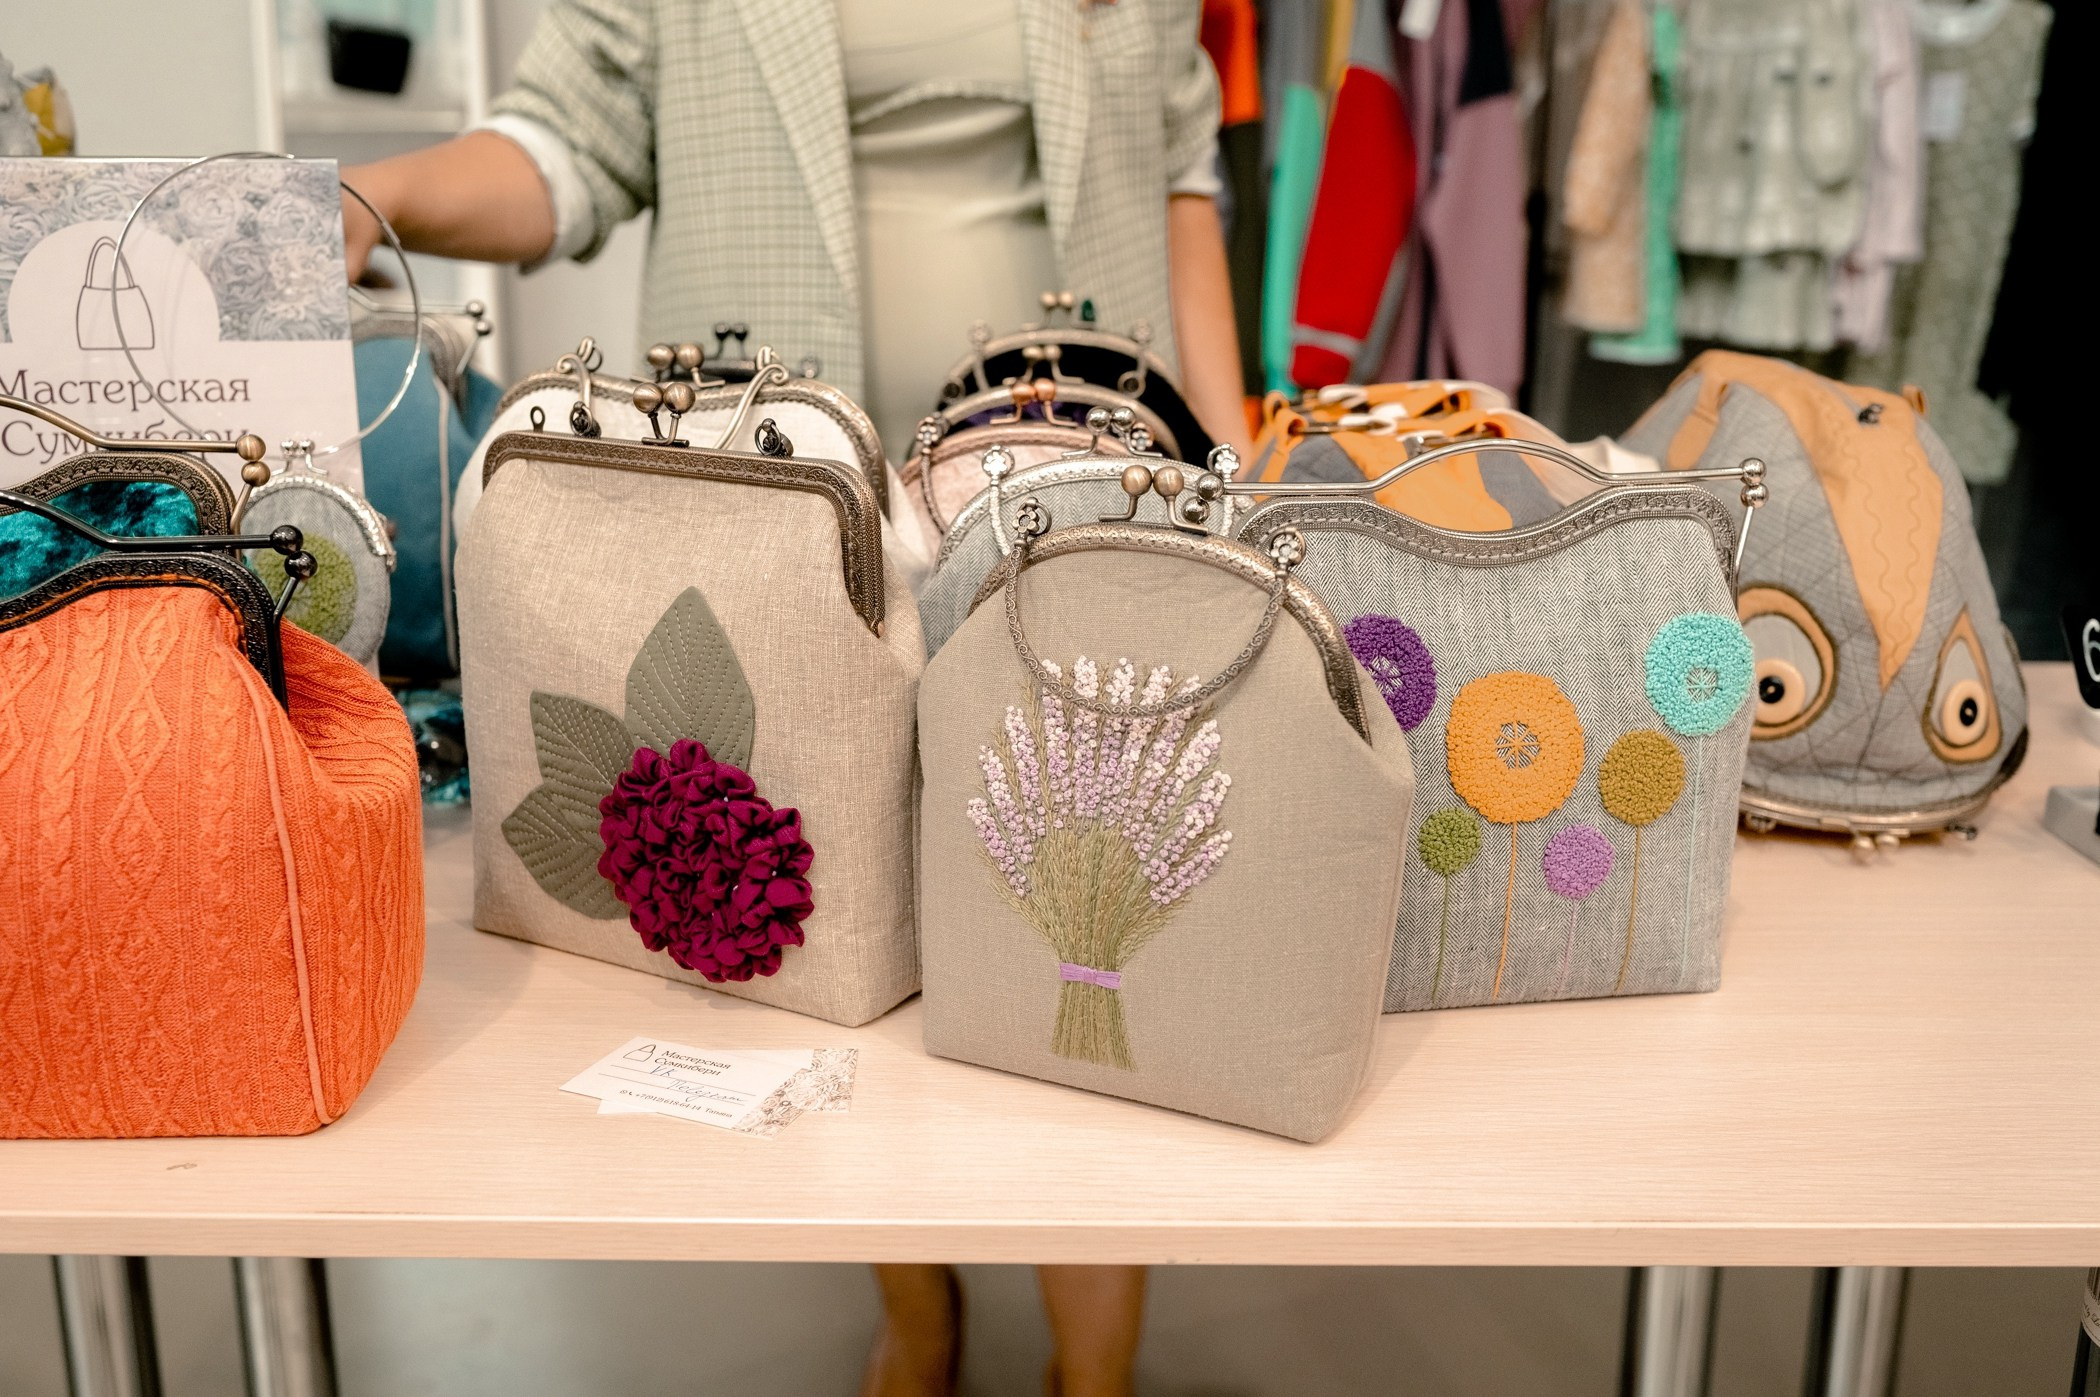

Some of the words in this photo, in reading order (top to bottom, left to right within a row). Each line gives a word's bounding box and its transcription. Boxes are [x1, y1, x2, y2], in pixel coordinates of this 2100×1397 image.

[0, 369, 250, 412] Мастерская
[655, 1058, 721, 1076] Сумкибери
[661, 1050, 731, 1069] Мастерская
